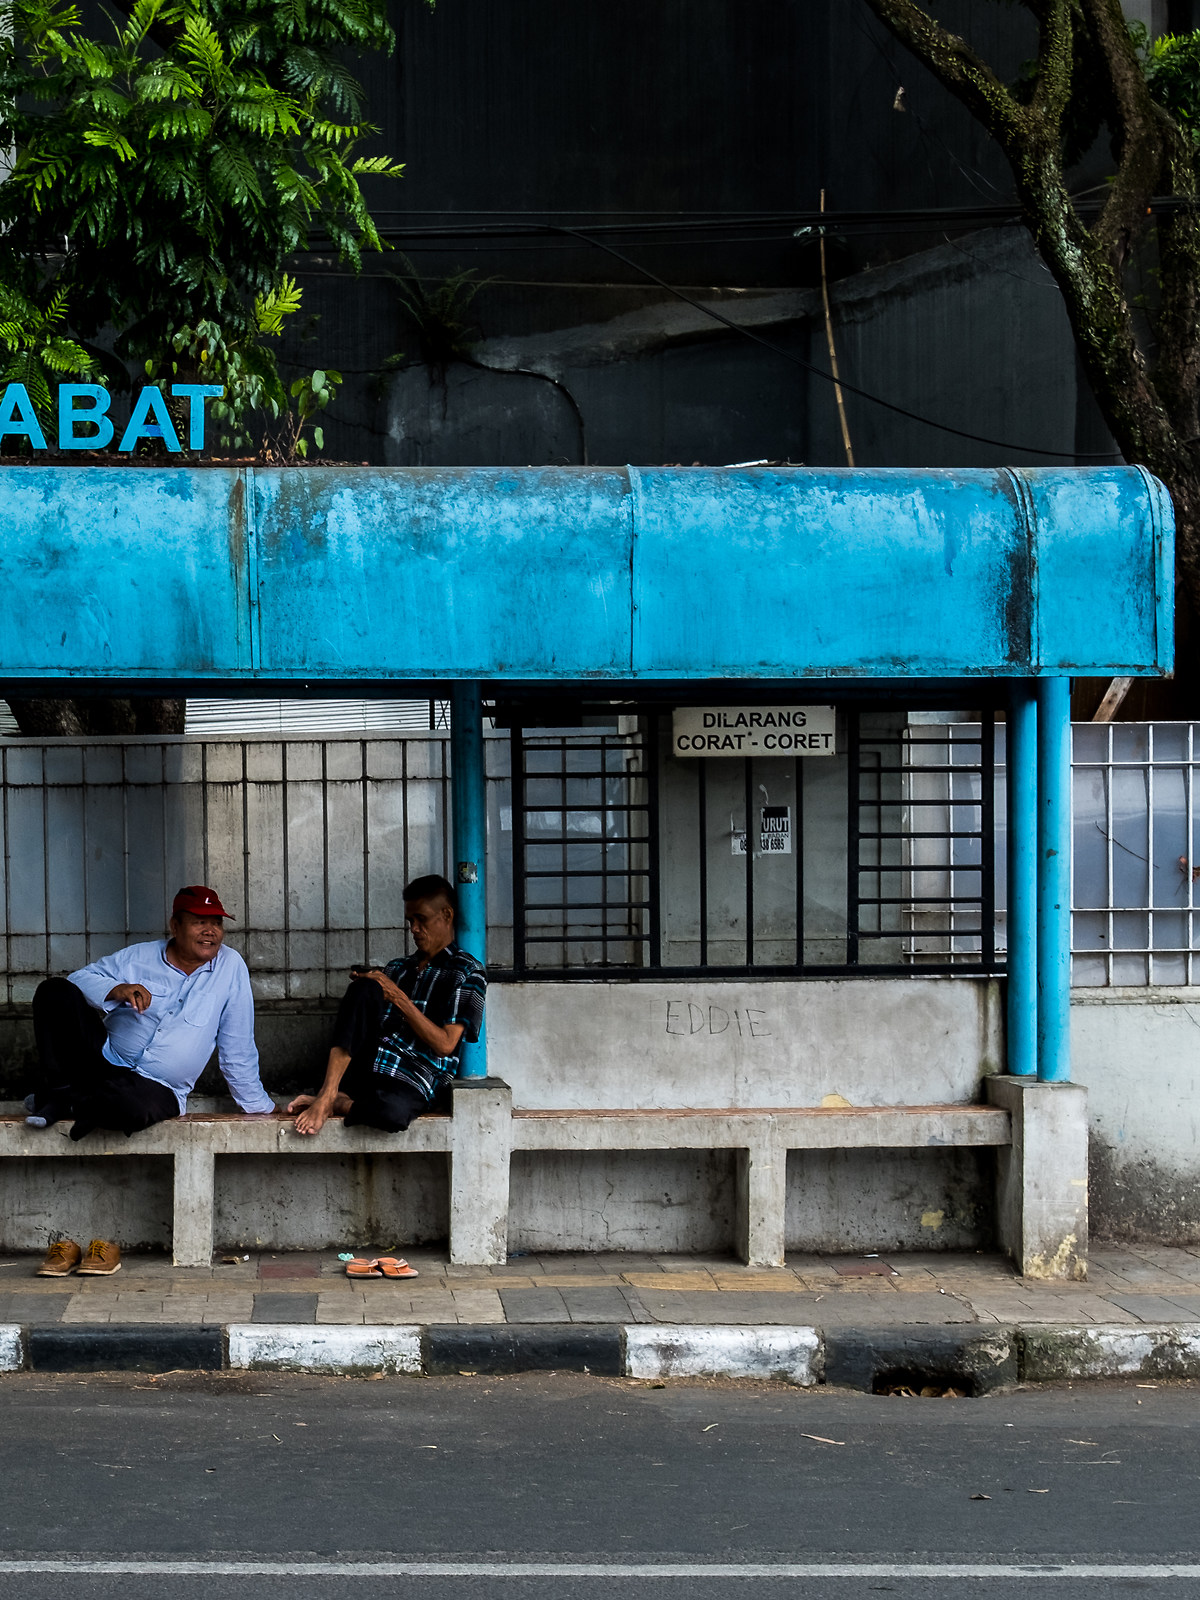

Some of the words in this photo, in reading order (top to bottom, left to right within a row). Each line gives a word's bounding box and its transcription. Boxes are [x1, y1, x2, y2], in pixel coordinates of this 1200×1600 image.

[703, 711, 807, 728] DILARANG
[677, 734, 746, 750] CORAT
[763, 733, 833, 749] CORET
[763, 817, 789, 832] URUT
[665, 1000, 773, 1037] EDDIE
